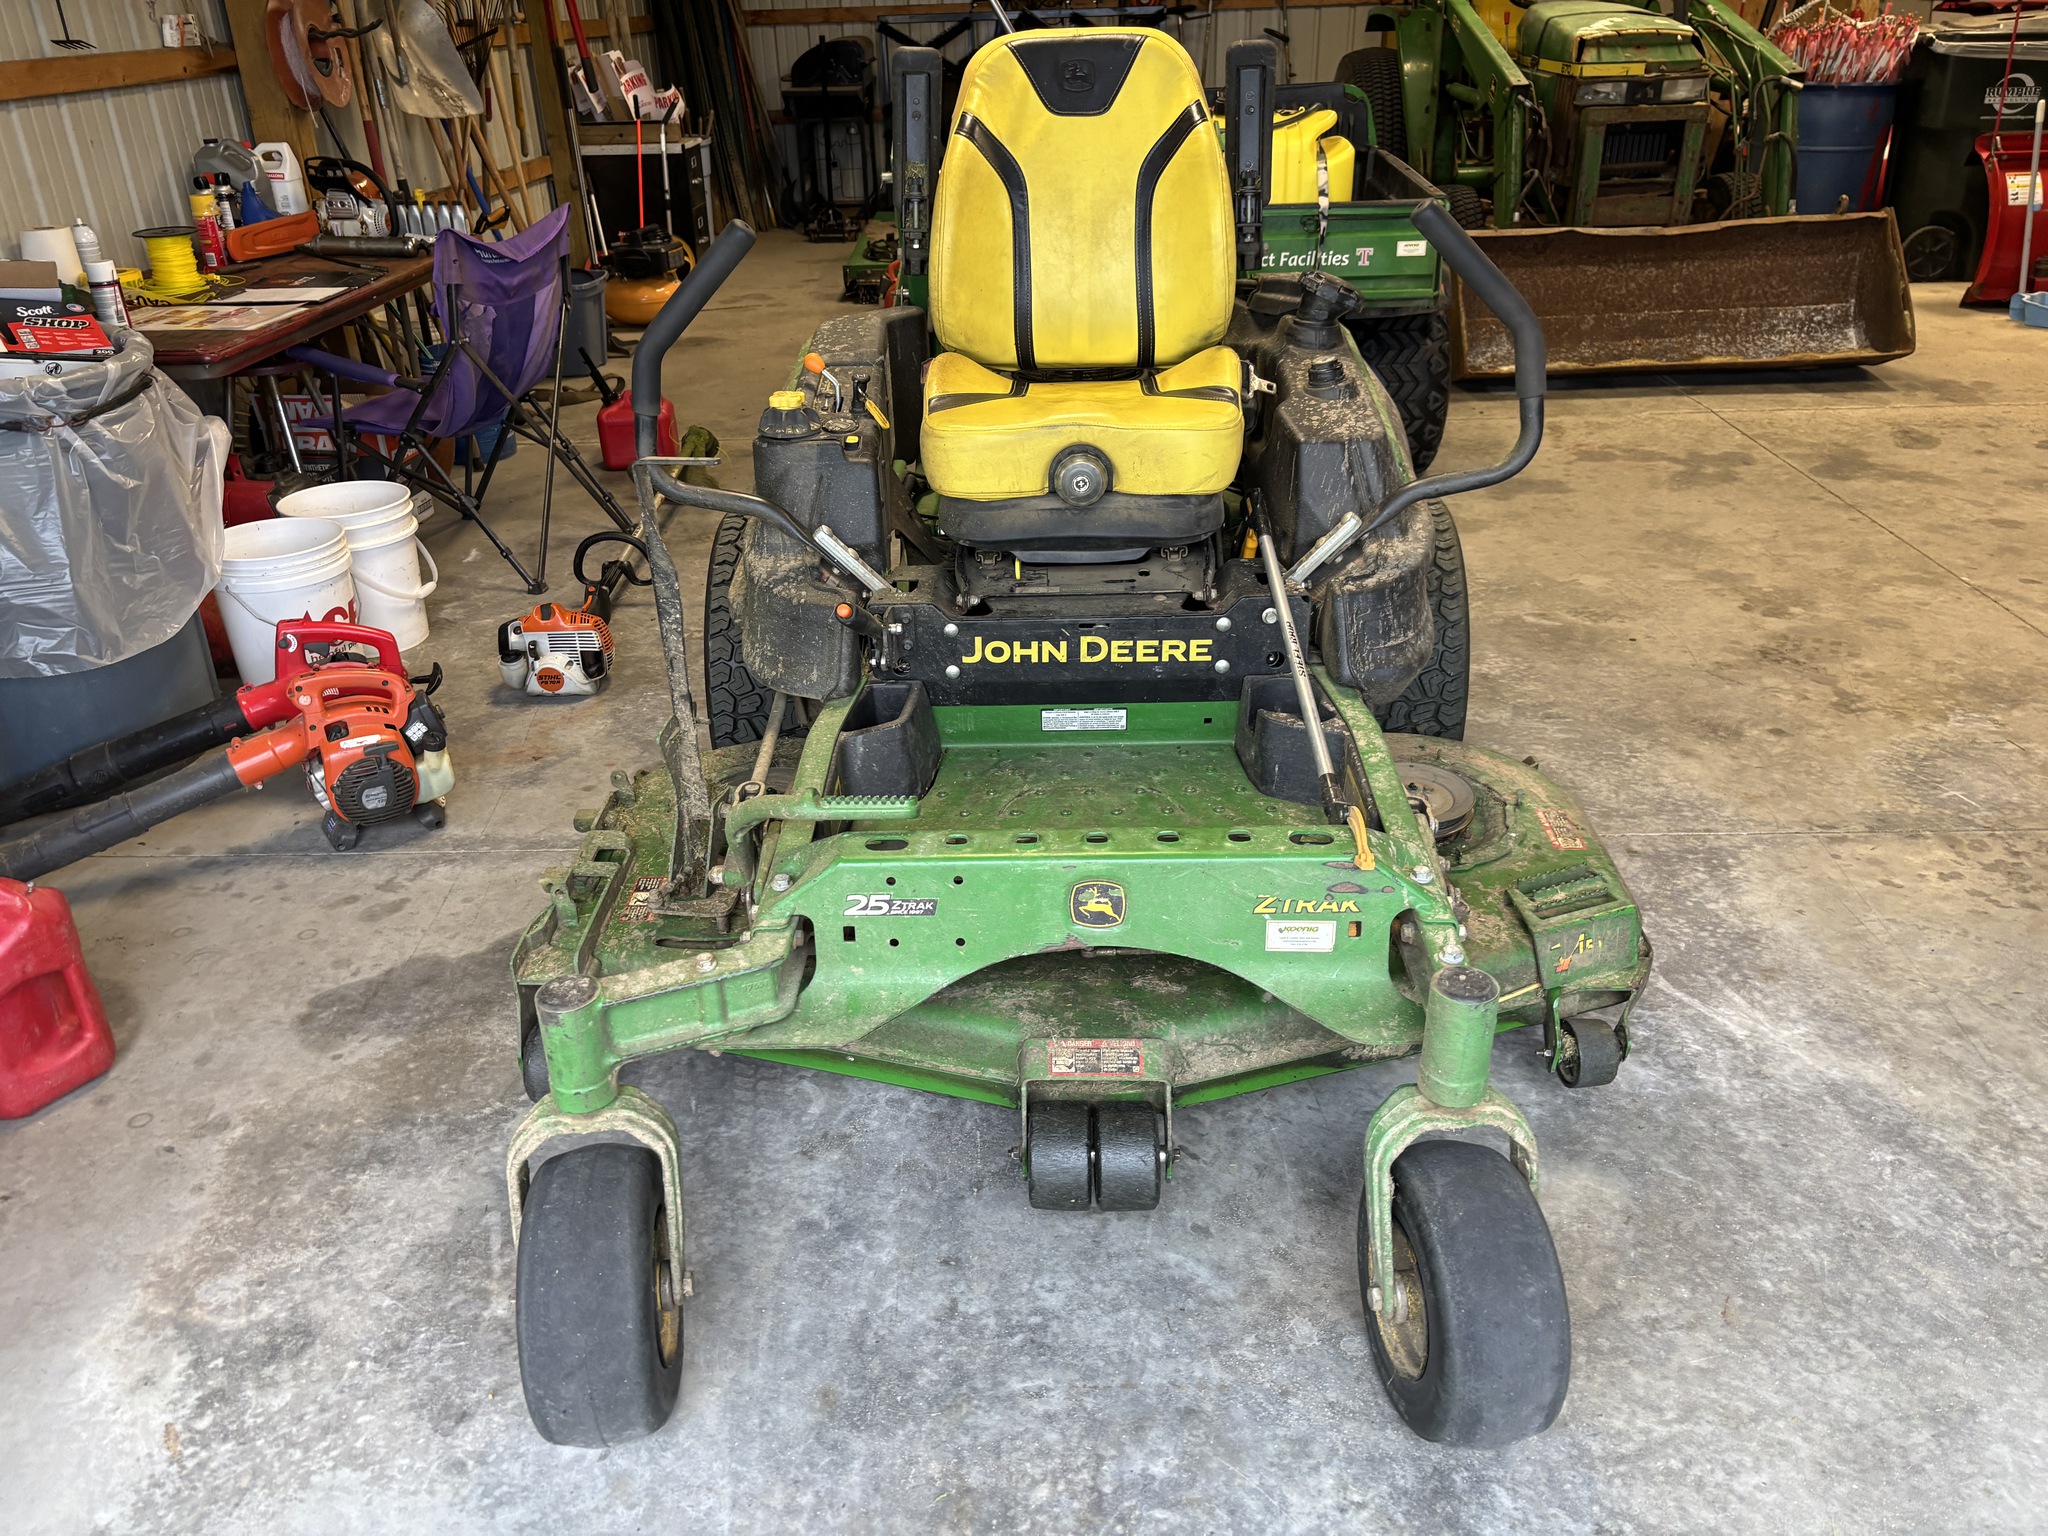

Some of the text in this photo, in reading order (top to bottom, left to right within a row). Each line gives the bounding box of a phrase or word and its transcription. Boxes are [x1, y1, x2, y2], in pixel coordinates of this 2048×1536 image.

[623, 73, 647, 97] ARKING
[1985, 87, 2042, 97] RUMPKE
[1280, 251, 1350, 267] Facilties
[16, 305, 52, 317] Scott
[23, 317, 91, 330] SHOP
[961, 635, 1213, 664] JOHN DEERE
[843, 894, 934, 916] 25 ZTRAK
[1253, 894, 1362, 914] ZTRAK
